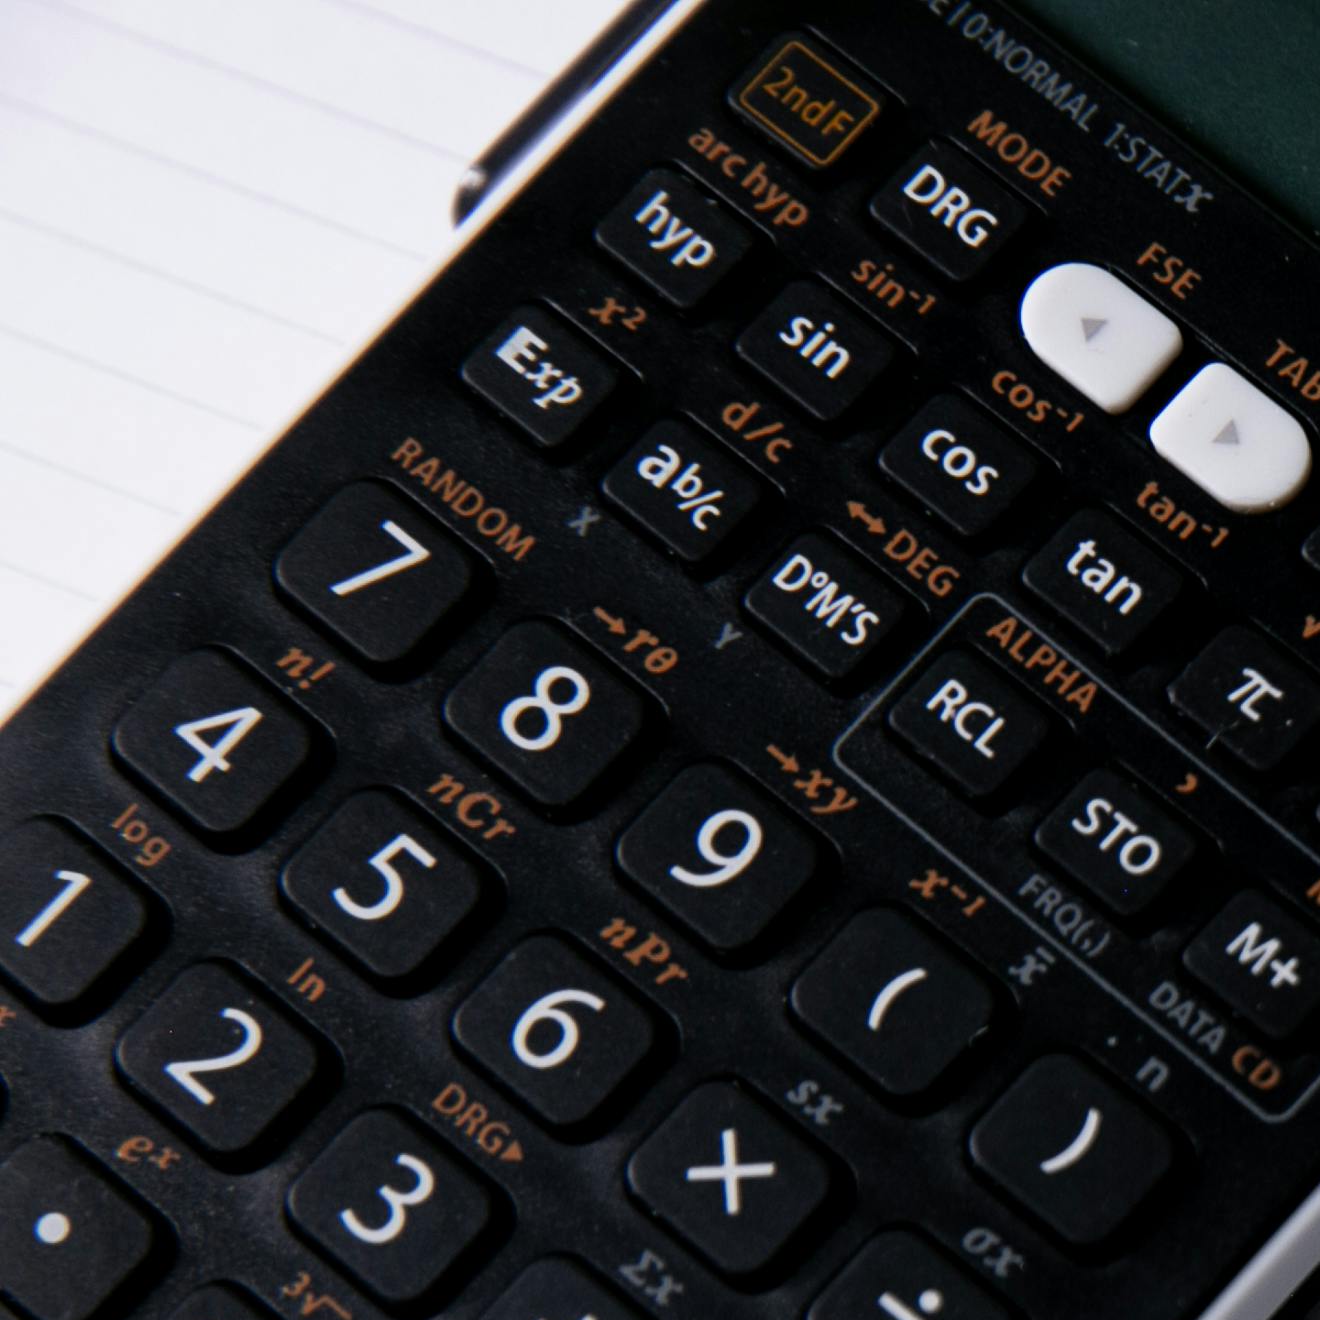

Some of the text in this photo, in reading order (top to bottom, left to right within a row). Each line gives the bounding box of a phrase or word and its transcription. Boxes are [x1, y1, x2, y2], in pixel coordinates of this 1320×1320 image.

[762, 66, 855, 137] 2ndF
[688, 128, 809, 228] arc hyp
[967, 110, 1072, 197] MODE
[635, 190, 716, 268] hyp
[902, 164, 998, 248] DRG
[1135, 242, 1202, 301] FSE
[495, 325, 583, 410] Exp
[778, 316, 850, 379] sin
[722, 402, 793, 464] d/c
[921, 428, 1000, 497] cos
[390, 437, 537, 562] RANDOM
[330, 519, 431, 596] 7
[883, 529, 960, 598] DEG
[1065, 538, 1143, 616] tan
[715, 622, 743, 649] Y
[986, 616, 1098, 714] ALPHA
[173, 707, 263, 783] 4
[500, 665, 591, 751] 8
[926, 679, 1005, 759] RCL
[110, 803, 172, 868] log
[425, 773, 517, 842] nCr
[1071, 797, 1161, 874] STO
[332, 833, 437, 921] 5
[669, 808, 763, 888] 9
[15, 869, 92, 948] 1
[600, 916, 689, 986] nPr
[1226, 922, 1299, 987] M+
[164, 1007, 263, 1106] 2
[512, 989, 605, 1069] 6
[1149, 981, 1281, 1091] DATA CD
[1136, 1056, 1169, 1092] n
[340, 1154, 435, 1244] 3
